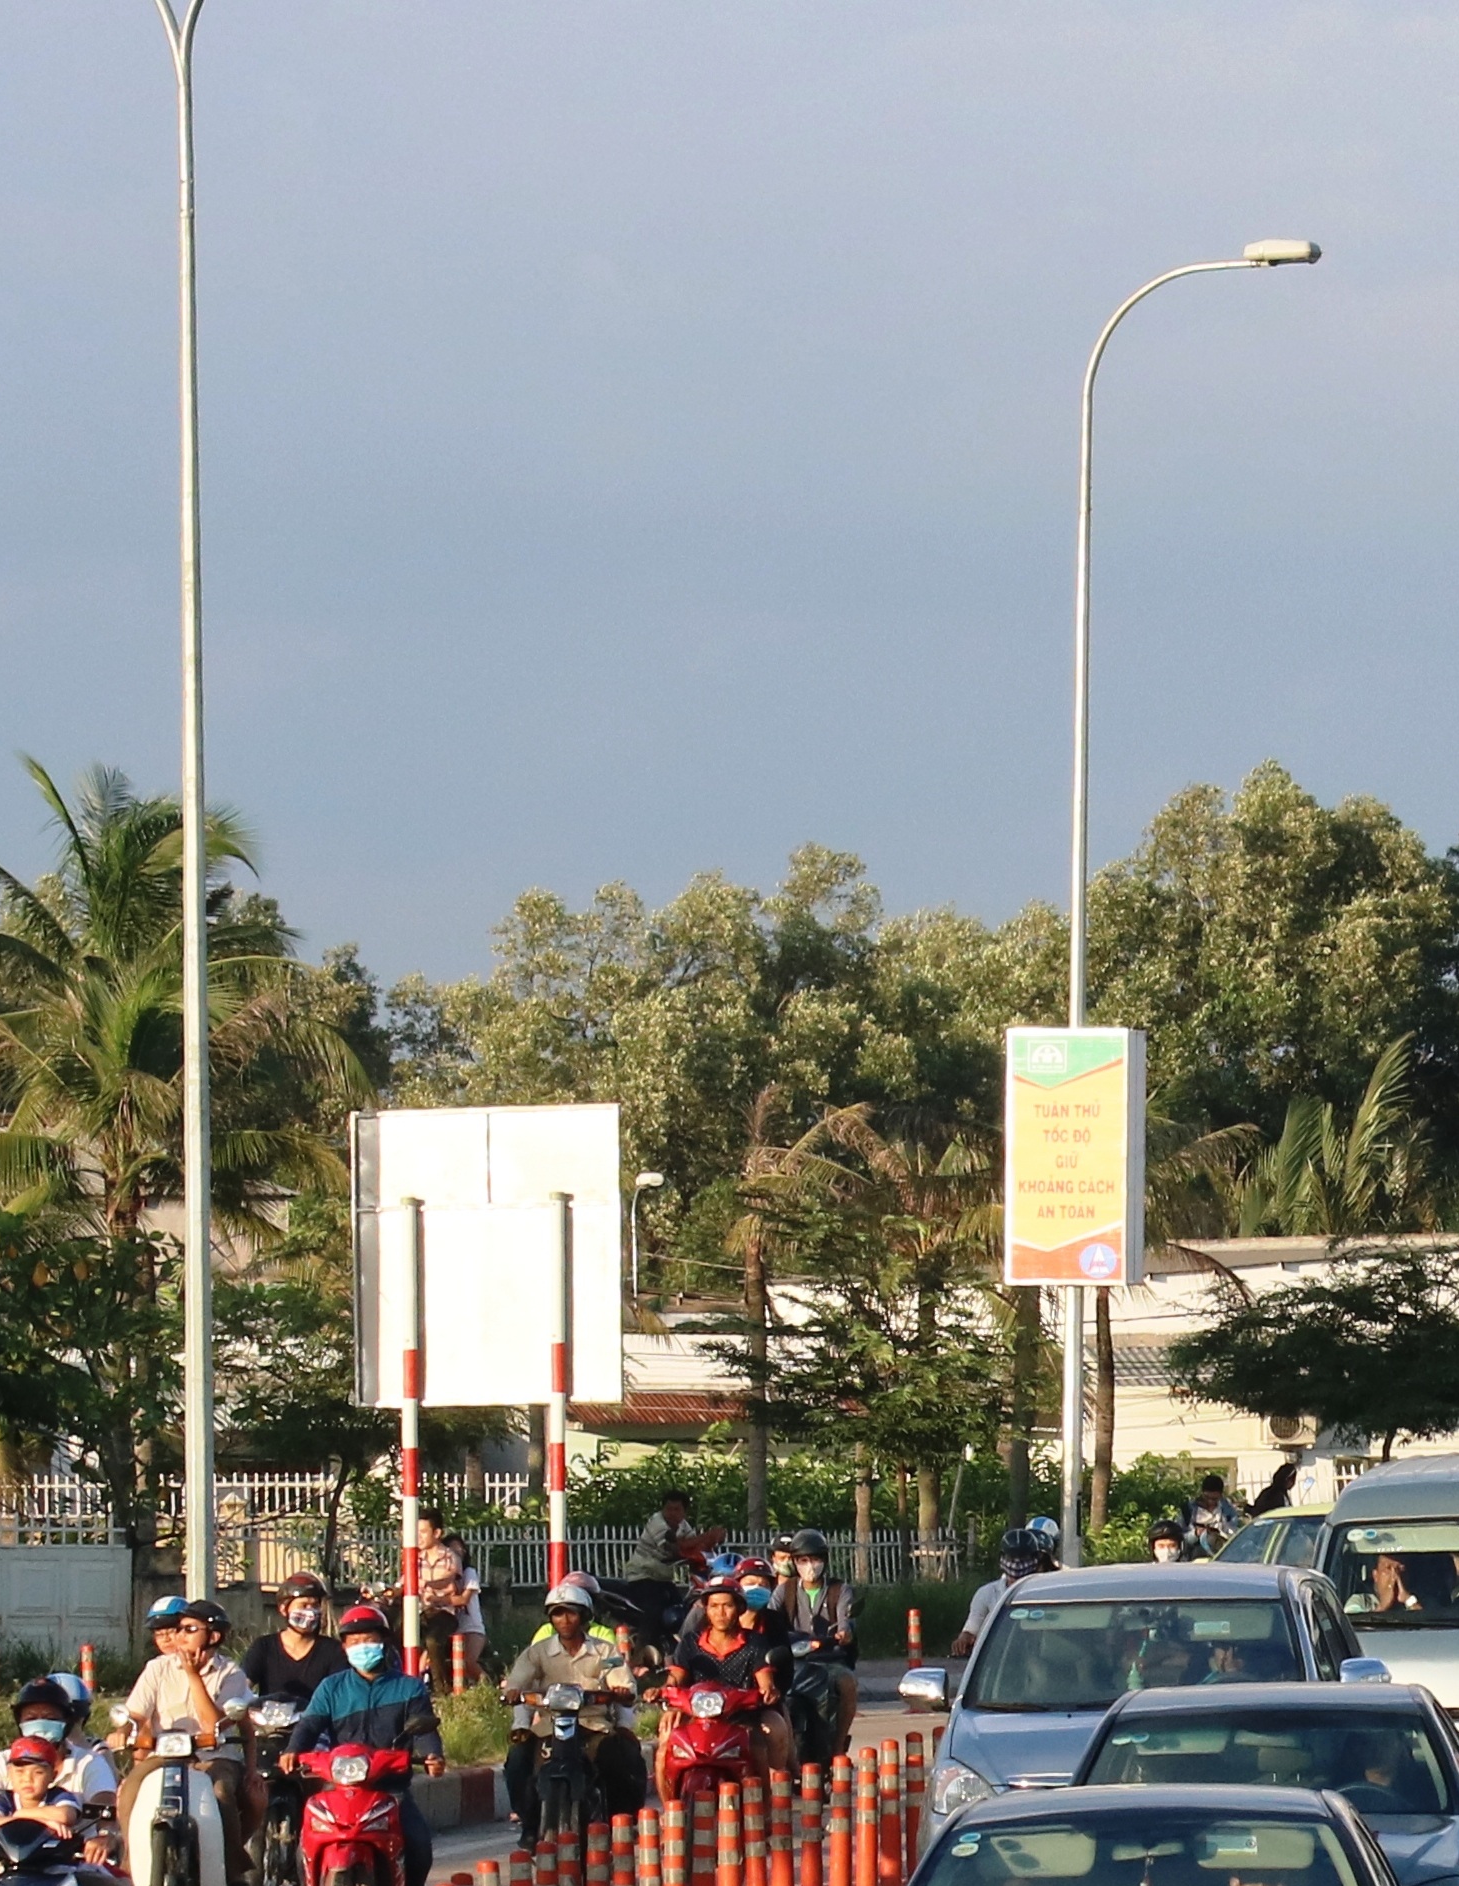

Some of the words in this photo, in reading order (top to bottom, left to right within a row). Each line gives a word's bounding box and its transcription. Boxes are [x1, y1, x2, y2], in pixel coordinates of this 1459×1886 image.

[1033, 1101, 1070, 1118] TUÂN
[1074, 1099, 1101, 1118] THỦ
[1042, 1124, 1068, 1143] TỐC
[1073, 1127, 1092, 1147] ĐỘ
[1018, 1175, 1074, 1194] KHOẢNG
[1078, 1176, 1115, 1194] CÁCH
[1037, 1205, 1055, 1219] AN
[1060, 1201, 1096, 1219] TOÀN
